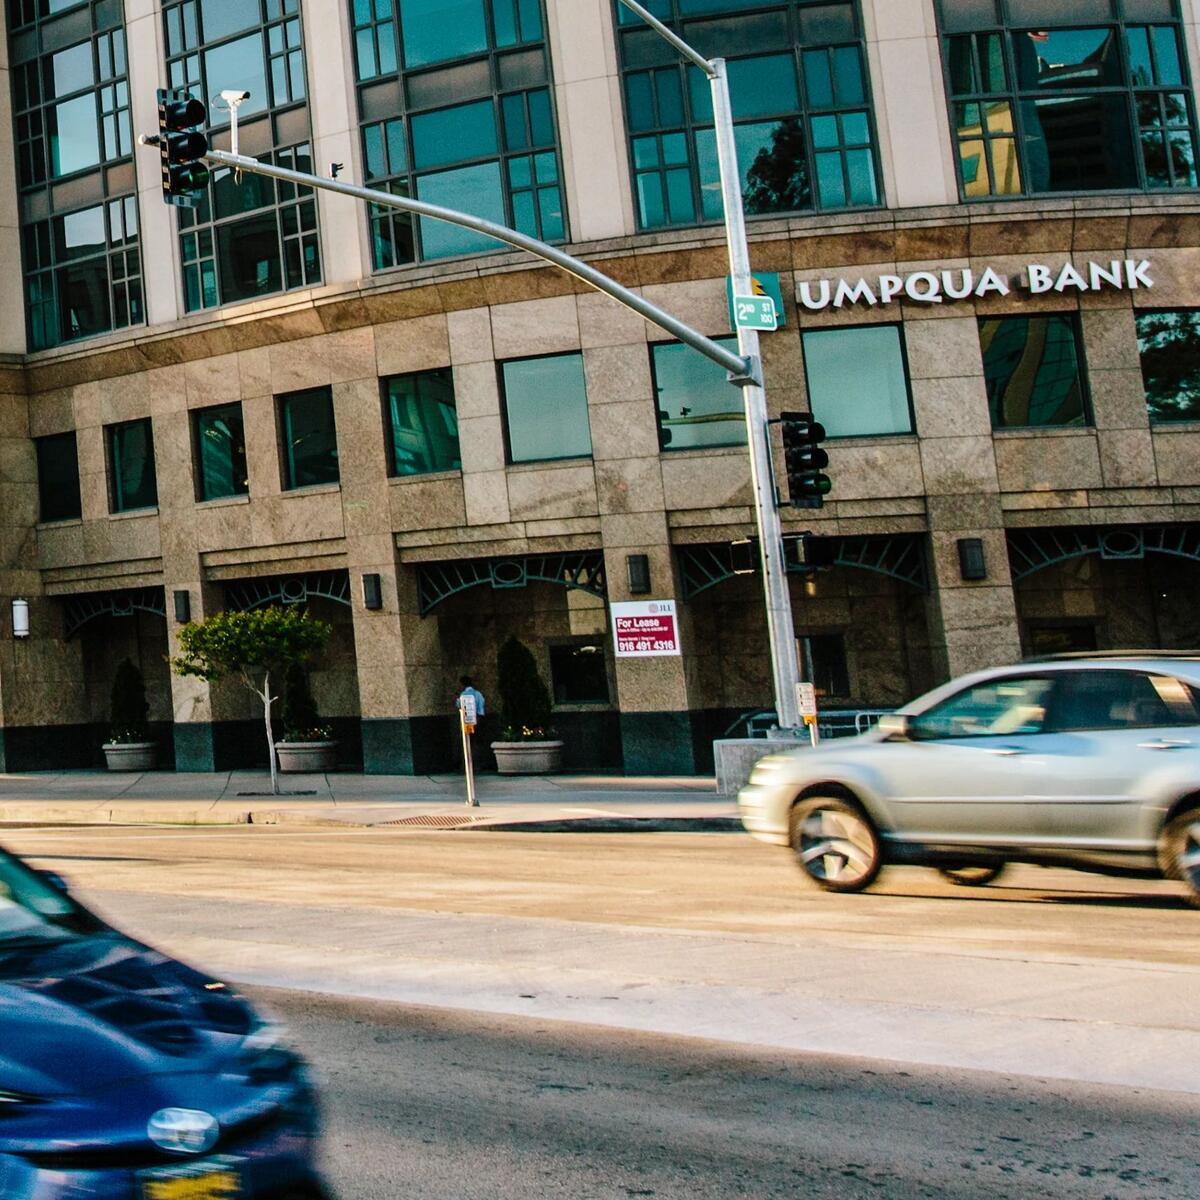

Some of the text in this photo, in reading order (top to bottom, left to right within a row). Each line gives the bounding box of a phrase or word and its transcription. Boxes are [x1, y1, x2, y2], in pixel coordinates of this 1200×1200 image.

[799, 259, 1155, 311] UMPQUA BANK
[616, 618, 660, 628] For Lease
[636, 641, 651, 651] 491
